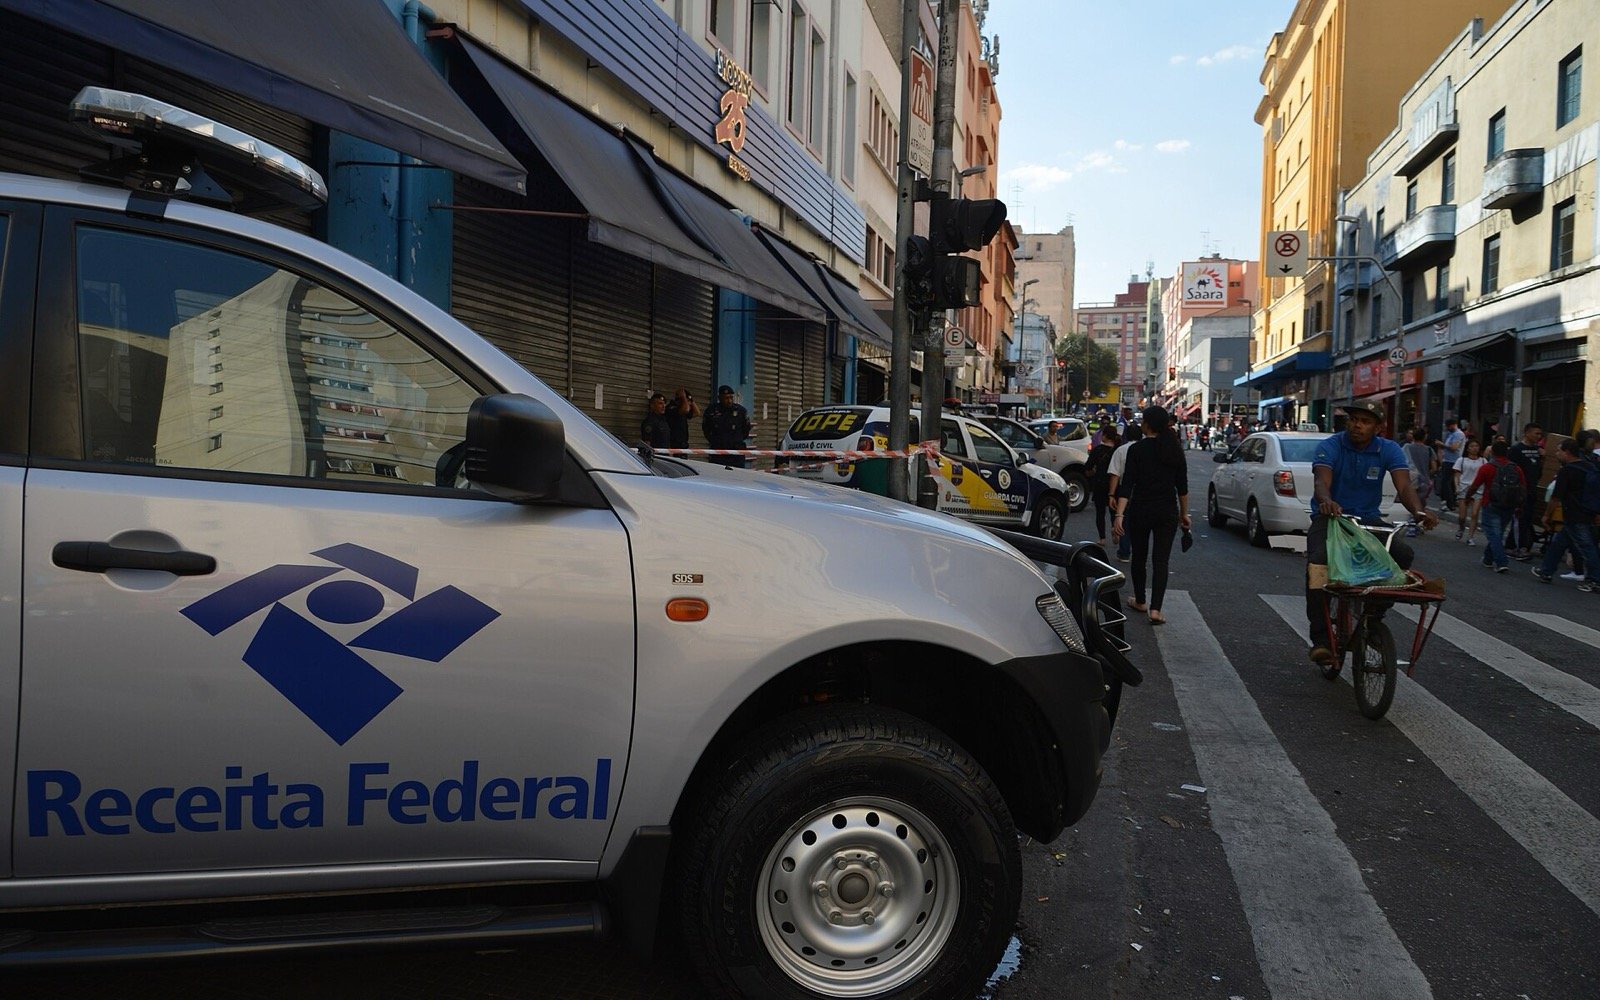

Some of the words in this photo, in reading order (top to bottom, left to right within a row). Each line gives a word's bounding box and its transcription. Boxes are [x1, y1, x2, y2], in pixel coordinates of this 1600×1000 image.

[1187, 287, 1223, 300] Saara
[951, 331, 959, 342] E
[1391, 350, 1404, 359] 40
[788, 442, 809, 450] GUARDA
[983, 491, 1010, 502] GUARDA
[1010, 494, 1026, 504] CIVIL
[674, 574, 694, 583] SDS
[27, 766, 324, 837] Receita
[347, 758, 612, 826] Federal
